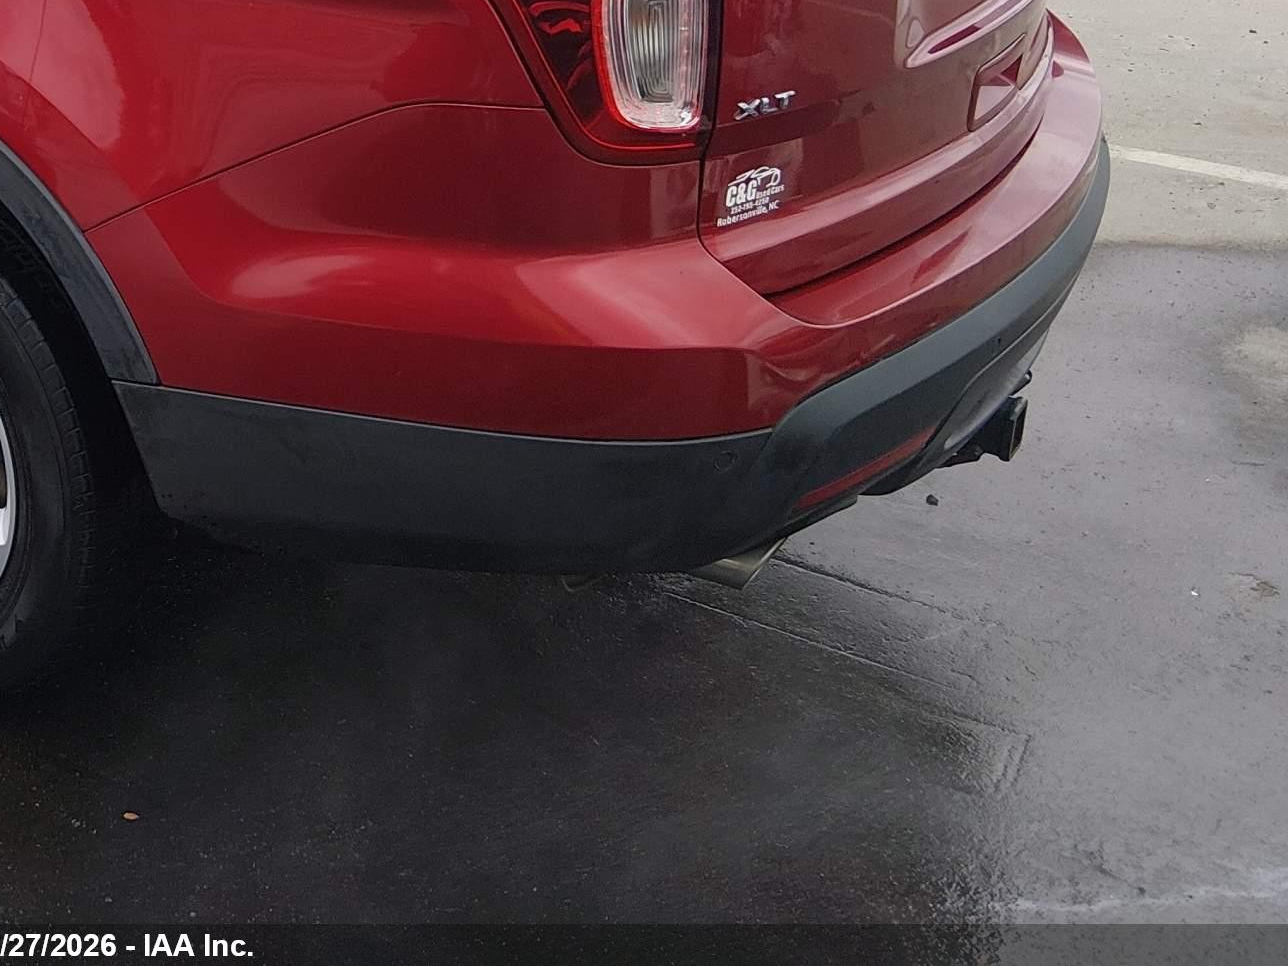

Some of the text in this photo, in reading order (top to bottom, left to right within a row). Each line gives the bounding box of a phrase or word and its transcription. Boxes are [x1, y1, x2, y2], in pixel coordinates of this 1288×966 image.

[734, 90, 796, 120] XLT
[725, 179, 758, 207] C&G
[768, 200, 780, 211] NC
